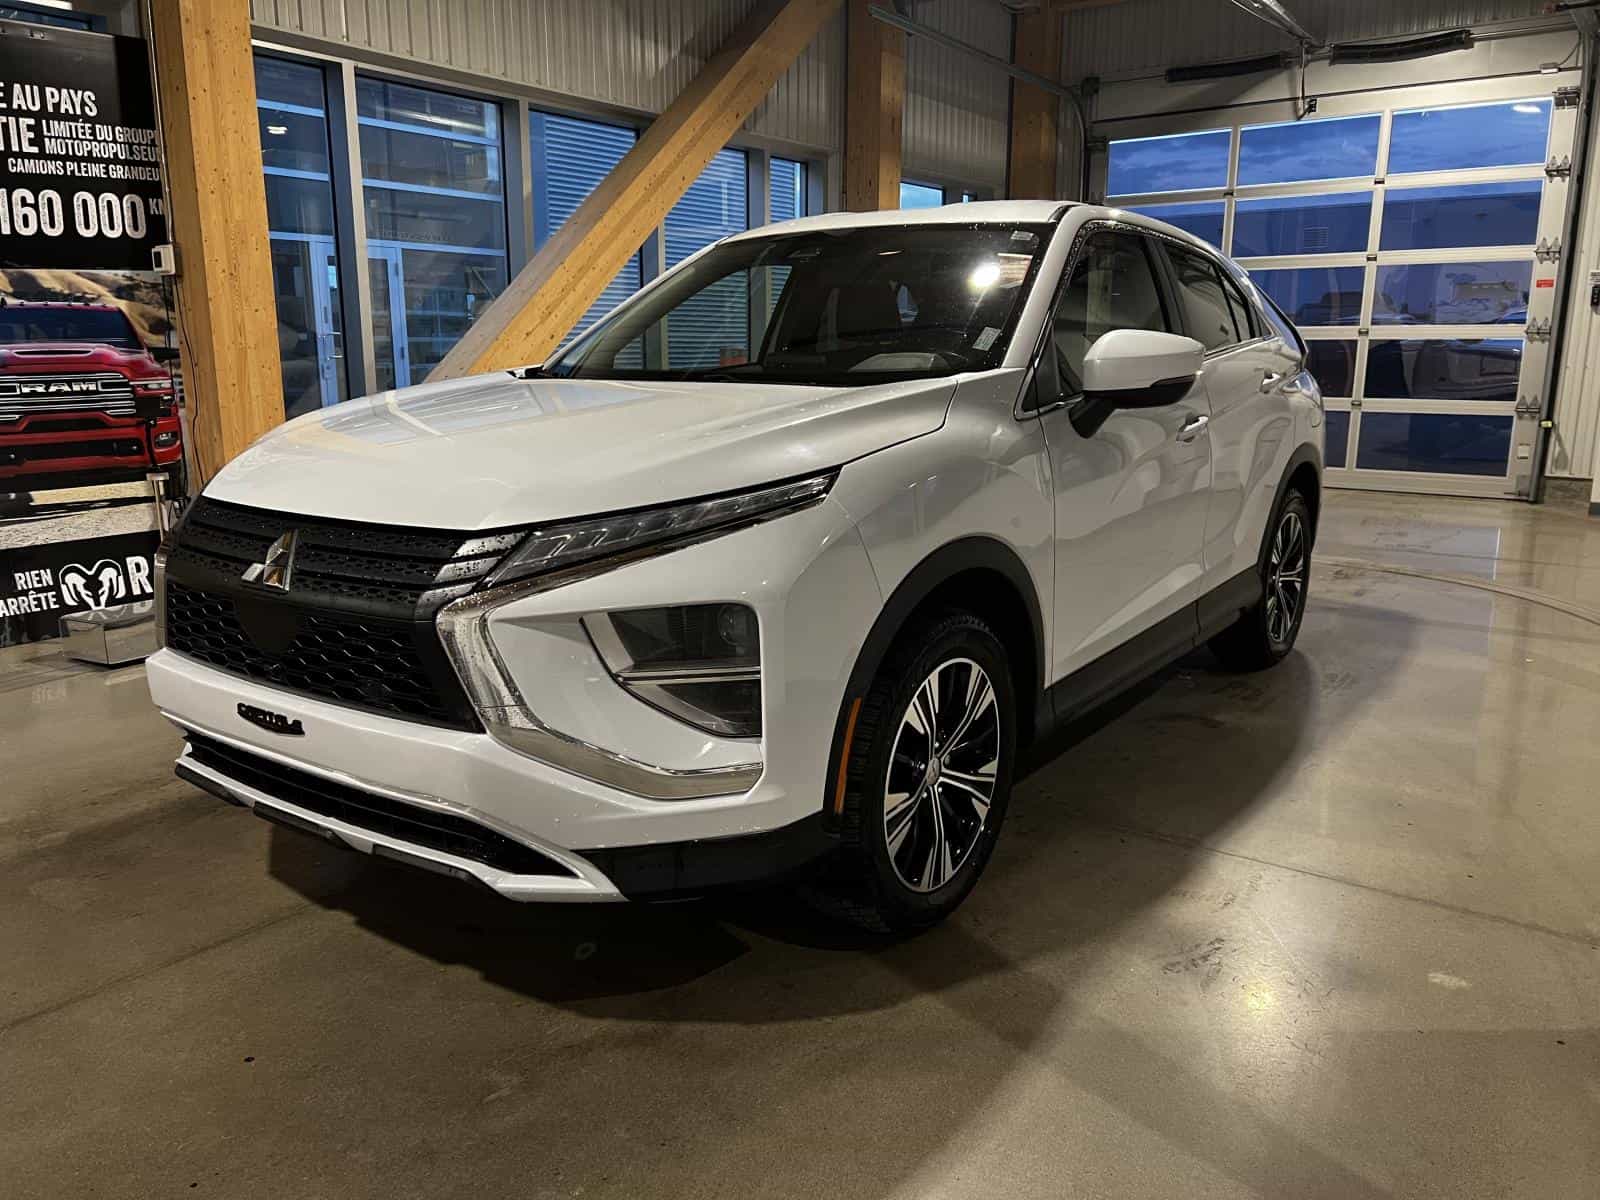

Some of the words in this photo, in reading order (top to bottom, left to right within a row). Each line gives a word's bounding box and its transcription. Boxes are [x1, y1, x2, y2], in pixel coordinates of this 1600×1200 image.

[12, 83, 41, 111] AU
[44, 86, 98, 117] PAYS
[42, 118, 94, 140] LIMITÉE
[95, 124, 113, 142] DU
[7, 157, 65, 176] CAMIONS
[66, 160, 108, 179] PLEINE
[108, 164, 160, 182] GRANDEU
[73, 190, 147, 239] 000
[20, 381, 97, 394] RAM
[14, 568, 54, 591] RIEN
